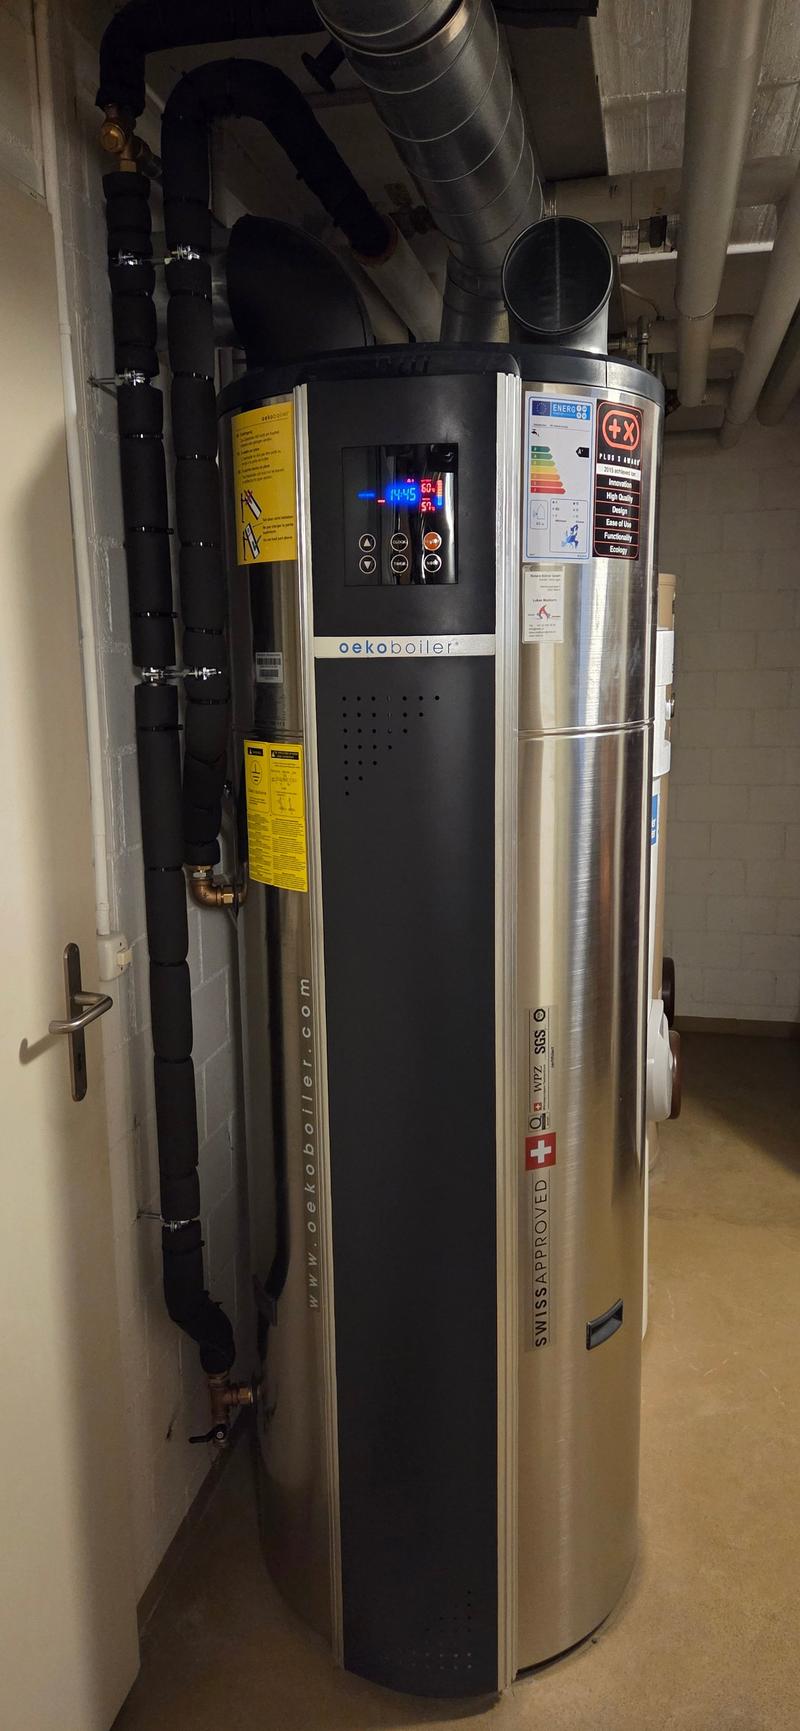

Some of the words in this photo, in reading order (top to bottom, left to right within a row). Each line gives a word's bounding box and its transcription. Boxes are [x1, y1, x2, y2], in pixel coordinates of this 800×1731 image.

[599, 452, 615, 462] PLUS
[617, 455, 621, 463] X
[608, 478, 632, 489] Innovation
[390, 487, 416, 502] 14:45
[606, 492, 618, 502] High
[618, 493, 634, 504] Quality
[611, 505, 628, 516] Design
[606, 518, 618, 527] Ease
[618, 519, 623, 528] of
[623, 520, 632, 529] Use
[603, 531, 632, 543] Functionality
[609, 545, 628, 556] Ecology
[534, 1029, 546, 1055] SGS
[533, 1065, 543, 1093] WPZ
[299, 978, 320, 1310] www.oekoboiler.com
[535, 1179, 548, 1348] SWISSAPPROVED
